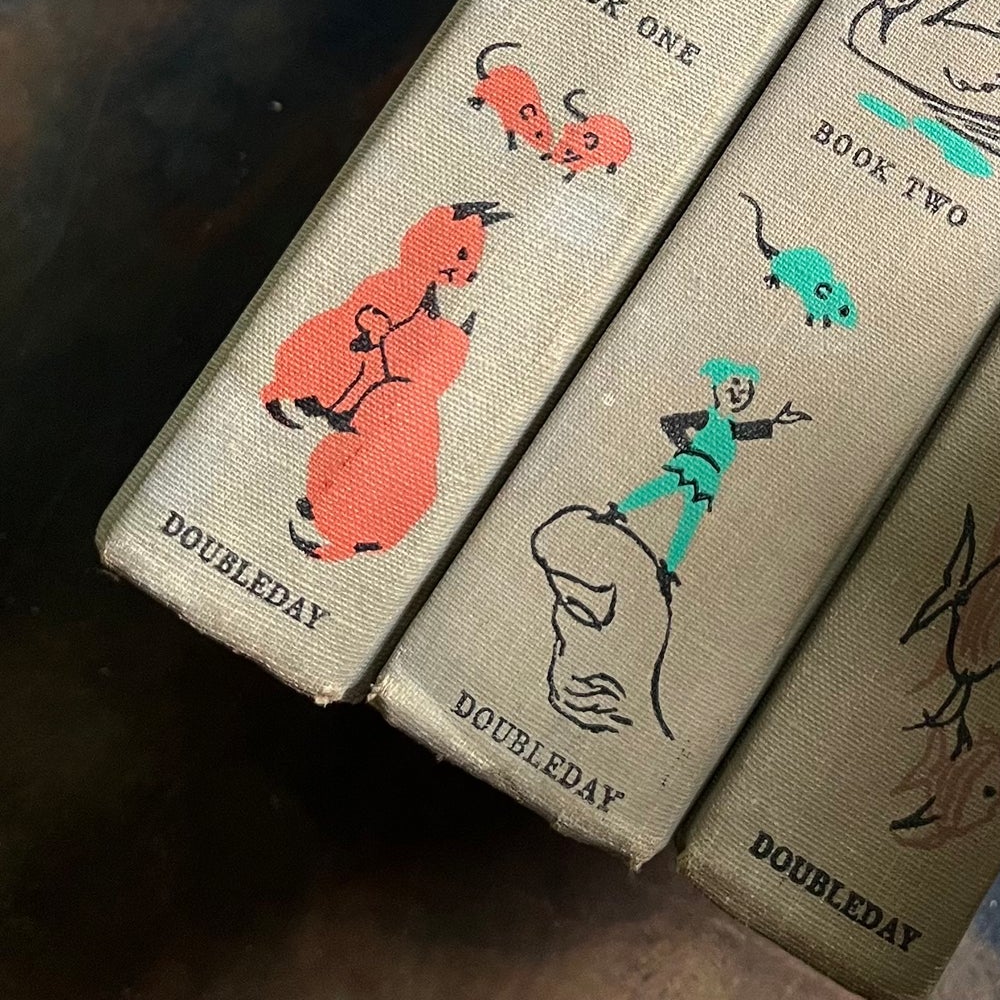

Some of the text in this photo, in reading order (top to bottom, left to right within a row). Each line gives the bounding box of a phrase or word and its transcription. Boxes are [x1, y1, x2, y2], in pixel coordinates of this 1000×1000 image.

[637, 15, 701, 67] ONE
[810, 119, 968, 226] BOOK TWO
[160, 510, 331, 629] DOUBLEDAY
[450, 689, 625, 813] DOUBLEDAY
[749, 830, 922, 952] DOUBLEDAY
